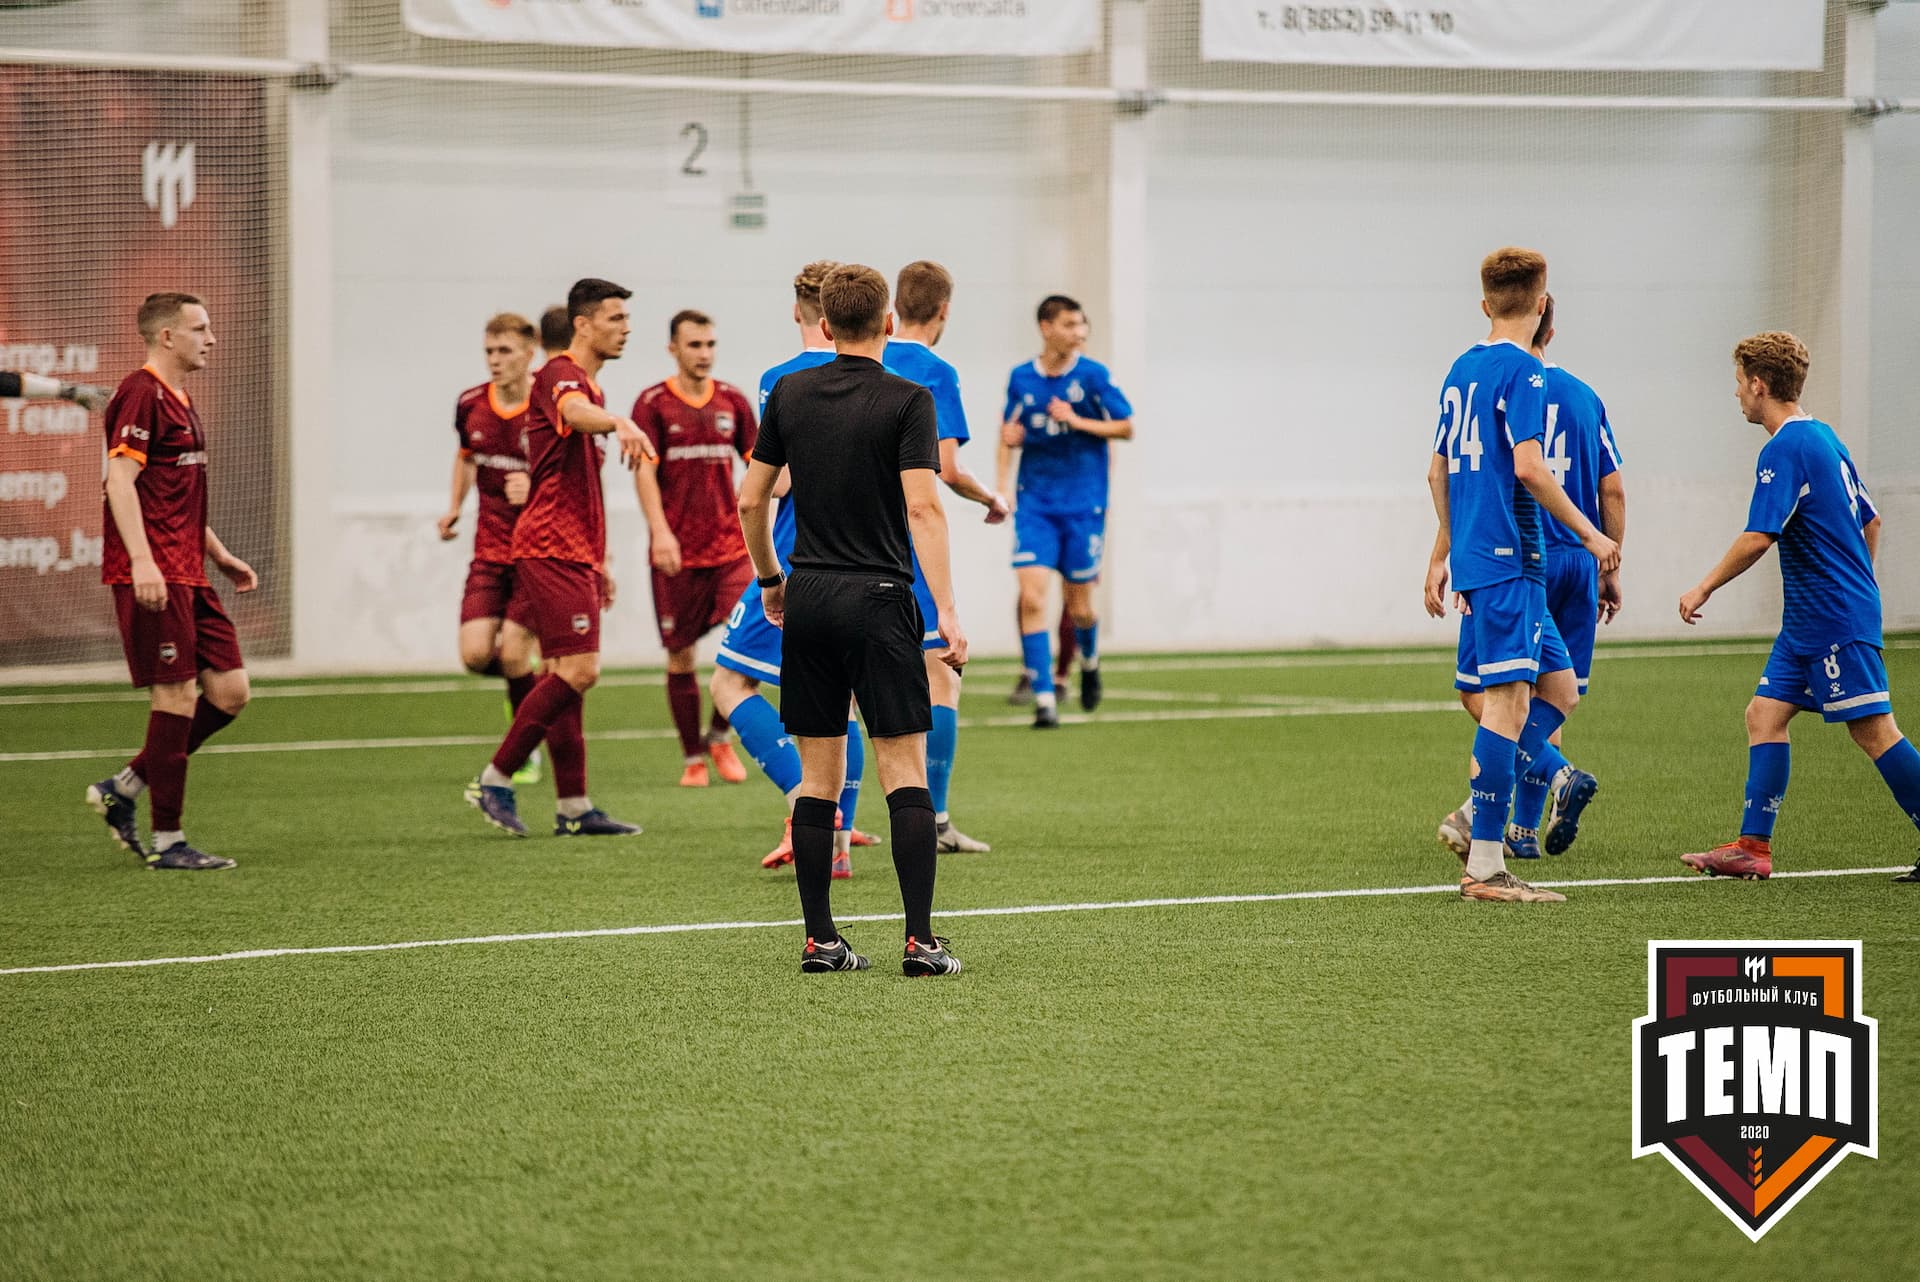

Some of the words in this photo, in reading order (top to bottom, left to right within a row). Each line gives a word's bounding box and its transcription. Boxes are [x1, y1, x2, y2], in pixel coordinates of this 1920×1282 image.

[680, 122, 708, 176] 2
[1444, 382, 1484, 474] 24
[1823, 654, 1841, 680] 8
